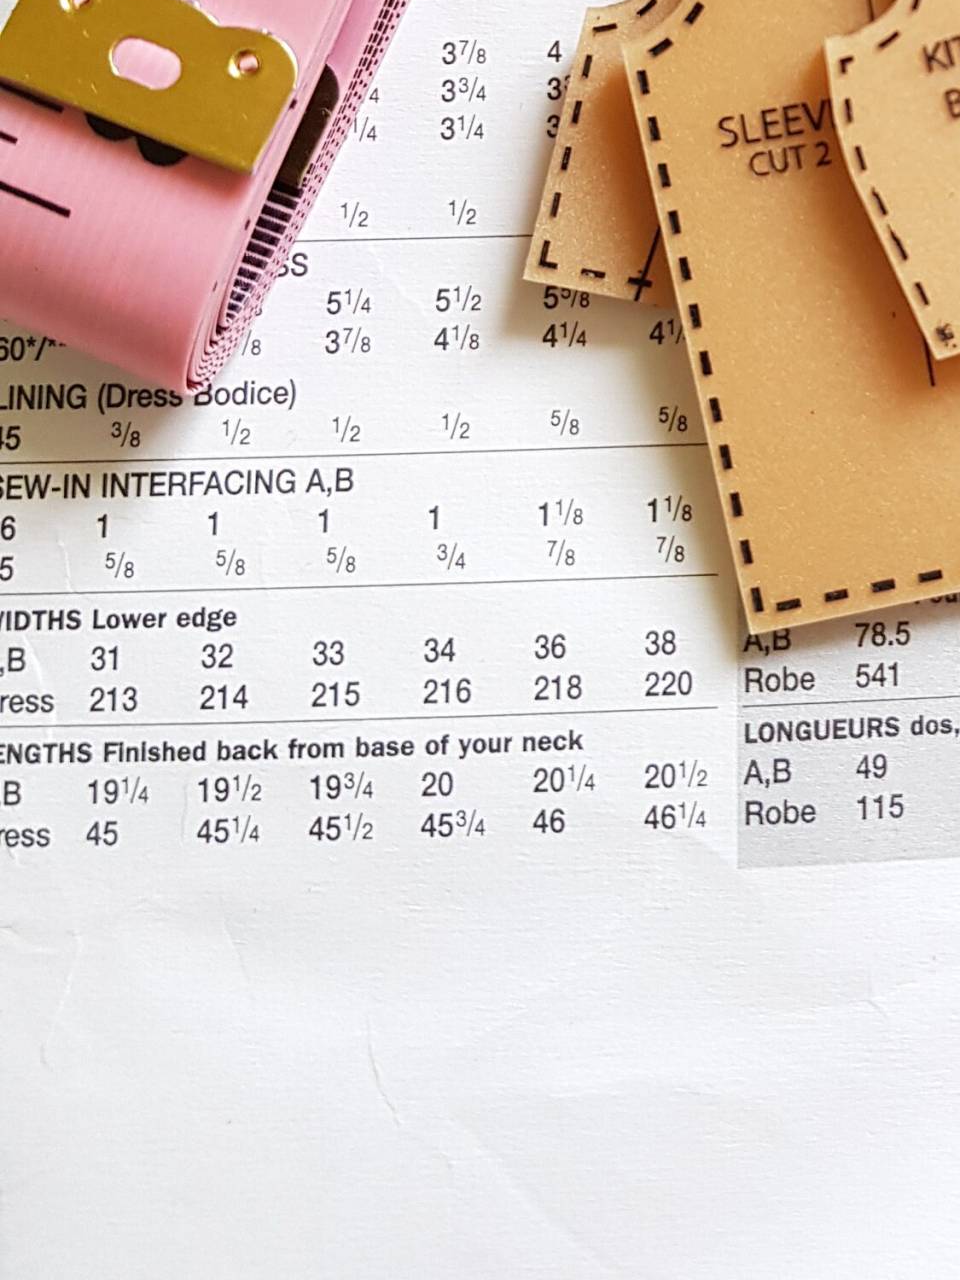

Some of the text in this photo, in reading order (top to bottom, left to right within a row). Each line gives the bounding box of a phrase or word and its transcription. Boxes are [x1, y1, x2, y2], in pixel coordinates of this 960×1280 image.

[717, 93, 834, 151] SLEEV
[748, 140, 833, 177] CUT 2
[98, 465, 354, 499] INTERFACING A,B
[92, 606, 237, 633] Lower edge
[90, 629, 677, 672] 31 32 33 34 36 38
[855, 661, 898, 689] 541
[103, 729, 584, 763] Finished back from base of your neck
[744, 716, 900, 744] LONGUEURS
[910, 714, 960, 738] dos,
